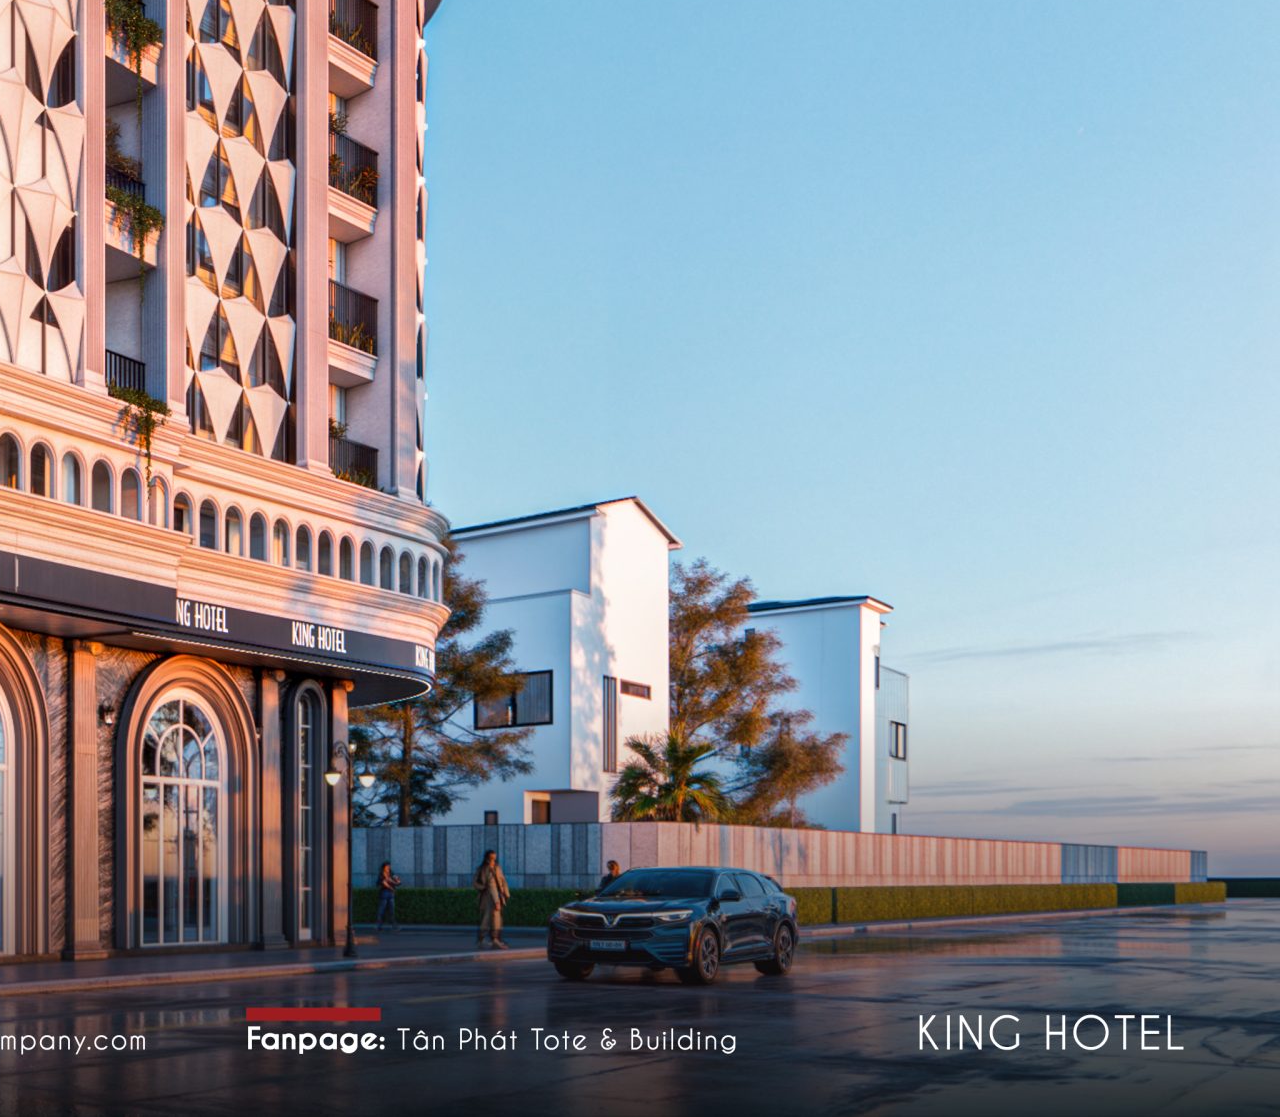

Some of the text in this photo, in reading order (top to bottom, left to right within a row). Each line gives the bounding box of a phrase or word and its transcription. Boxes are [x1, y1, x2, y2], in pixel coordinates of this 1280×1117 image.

[194, 602, 229, 633] HOTEL
[292, 621, 347, 653] KING HOTEL
